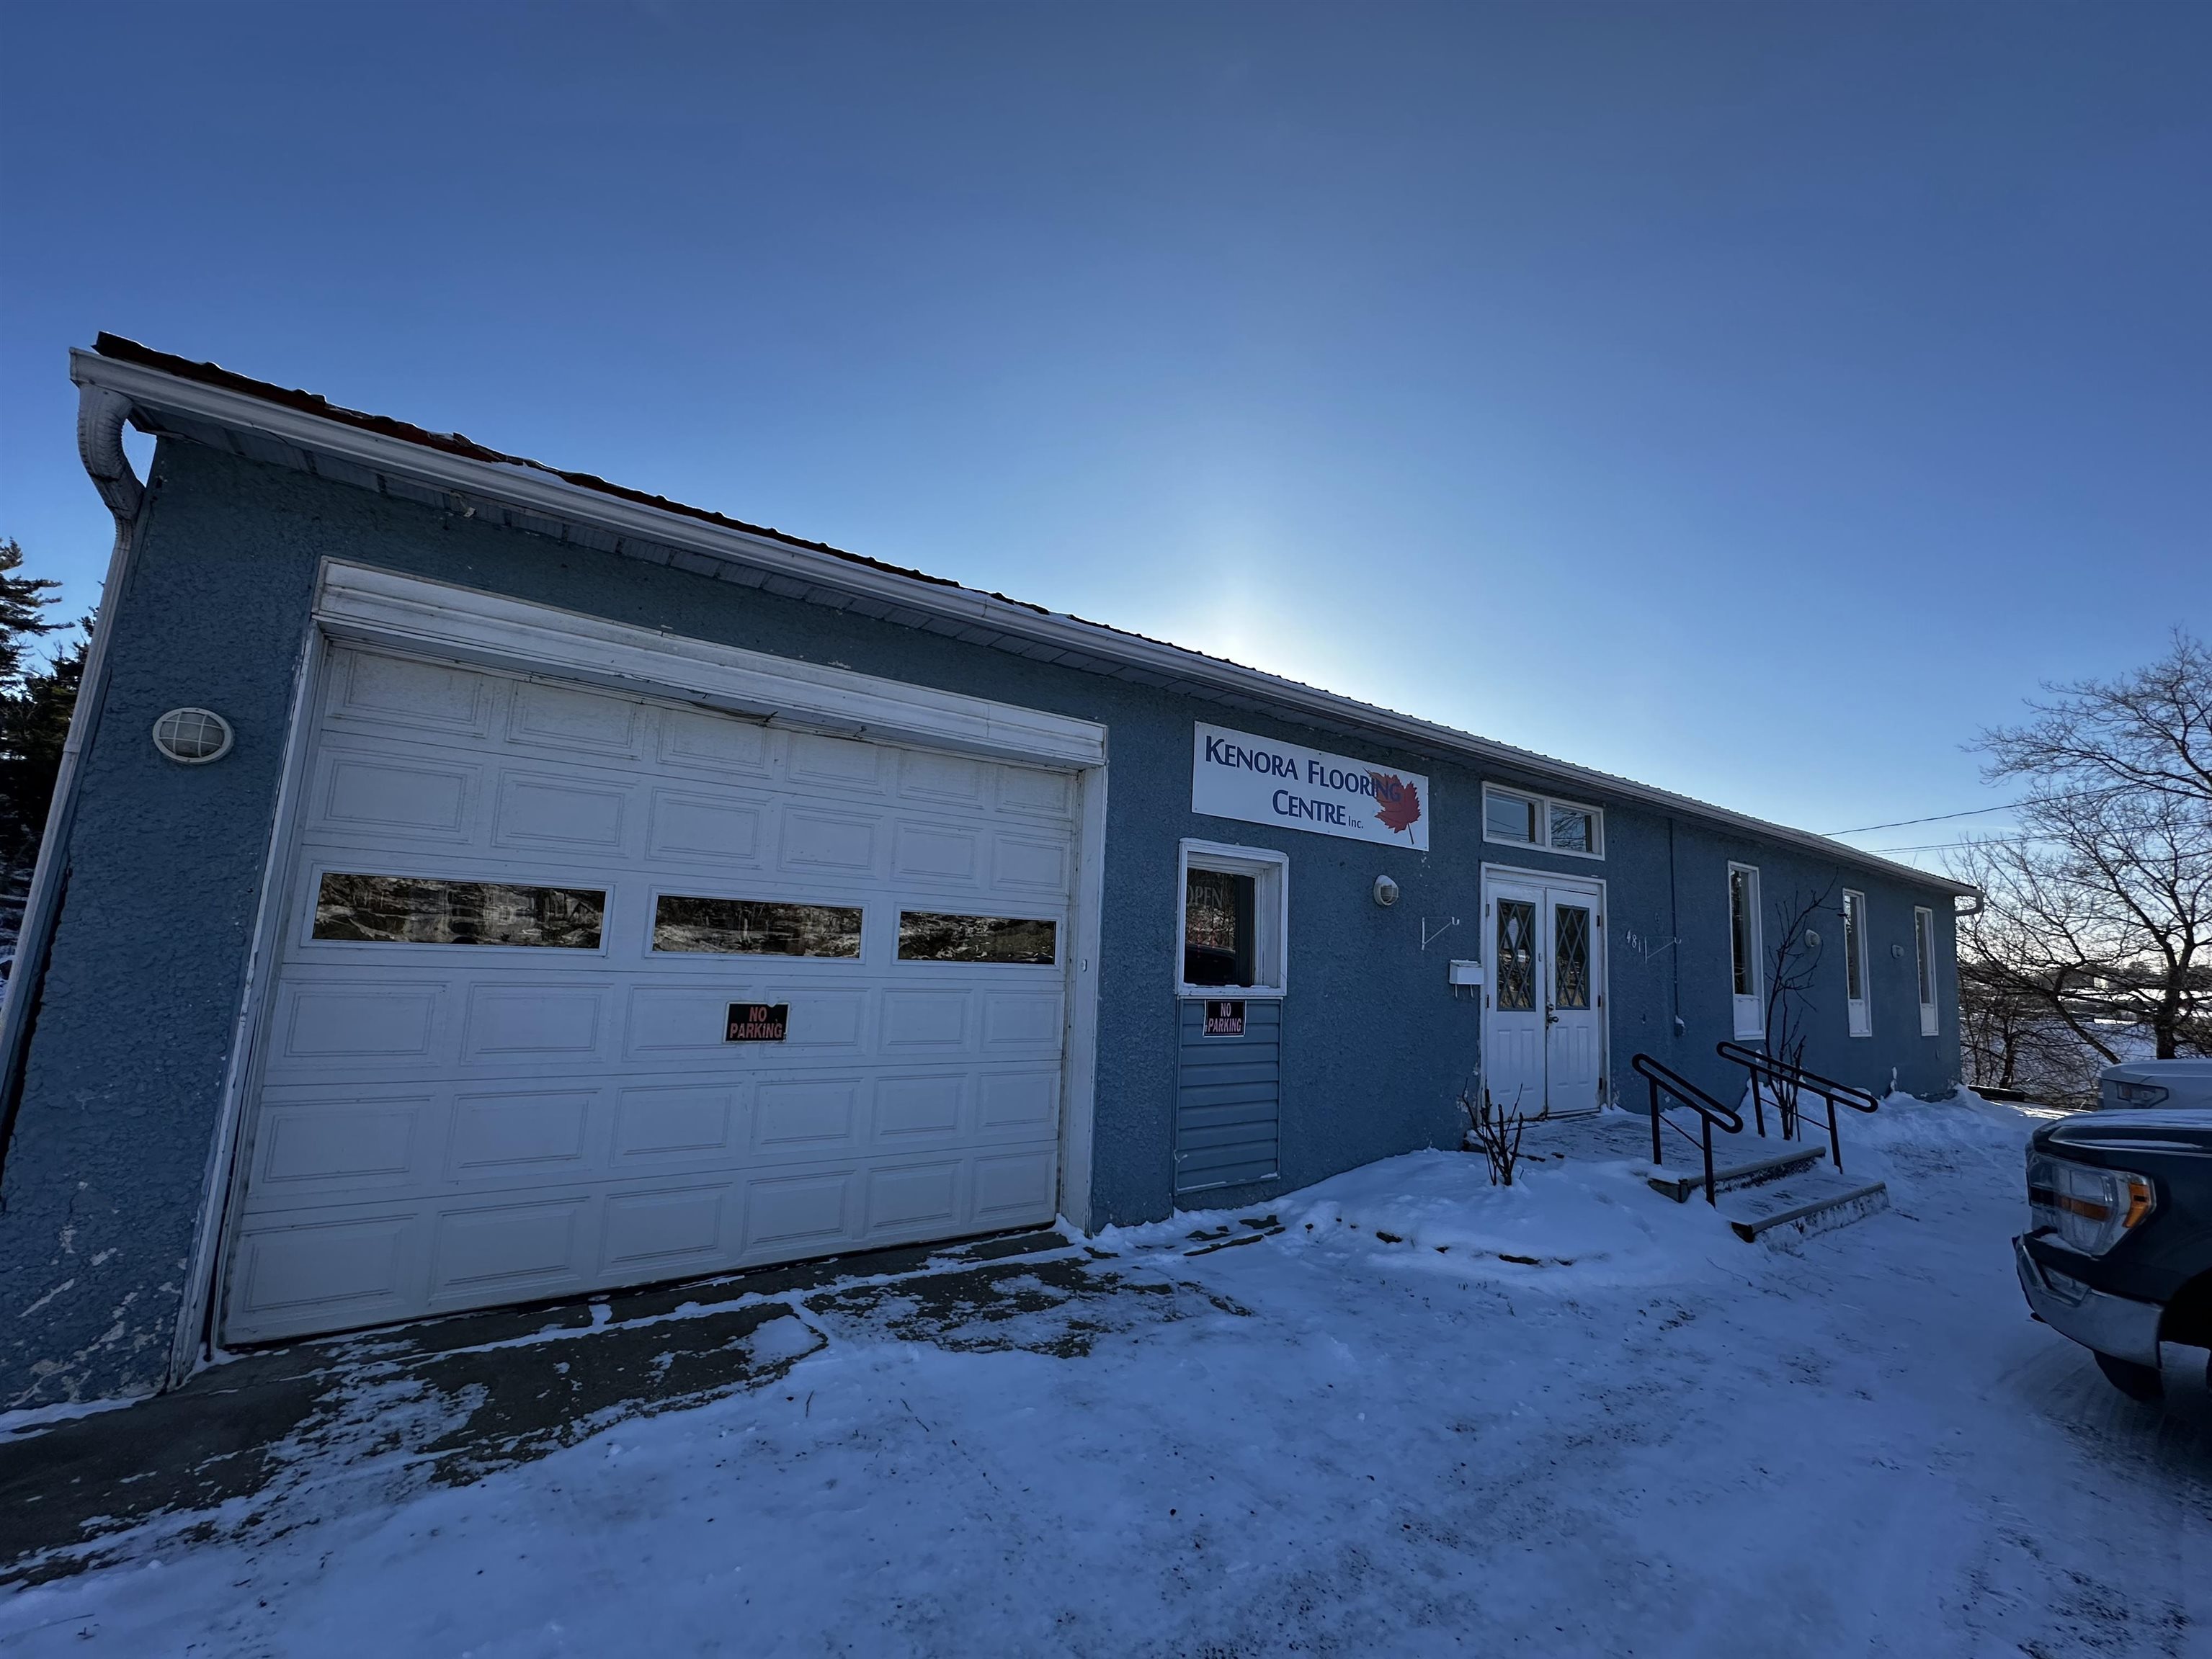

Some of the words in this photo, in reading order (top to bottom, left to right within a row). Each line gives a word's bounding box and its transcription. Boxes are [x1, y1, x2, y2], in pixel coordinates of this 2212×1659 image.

[1205, 735, 1298, 780] KENORA
[1308, 759, 1401, 802] FLOORING
[1272, 790, 1346, 826] CENTRE
[1348, 816, 1364, 829] Inc.
[749, 1006, 767, 1022] NO
[1221, 1002, 1231, 1017] NO
[729, 1023, 782, 1039] PARKING
[1208, 1018, 1241, 1032] PARKING
